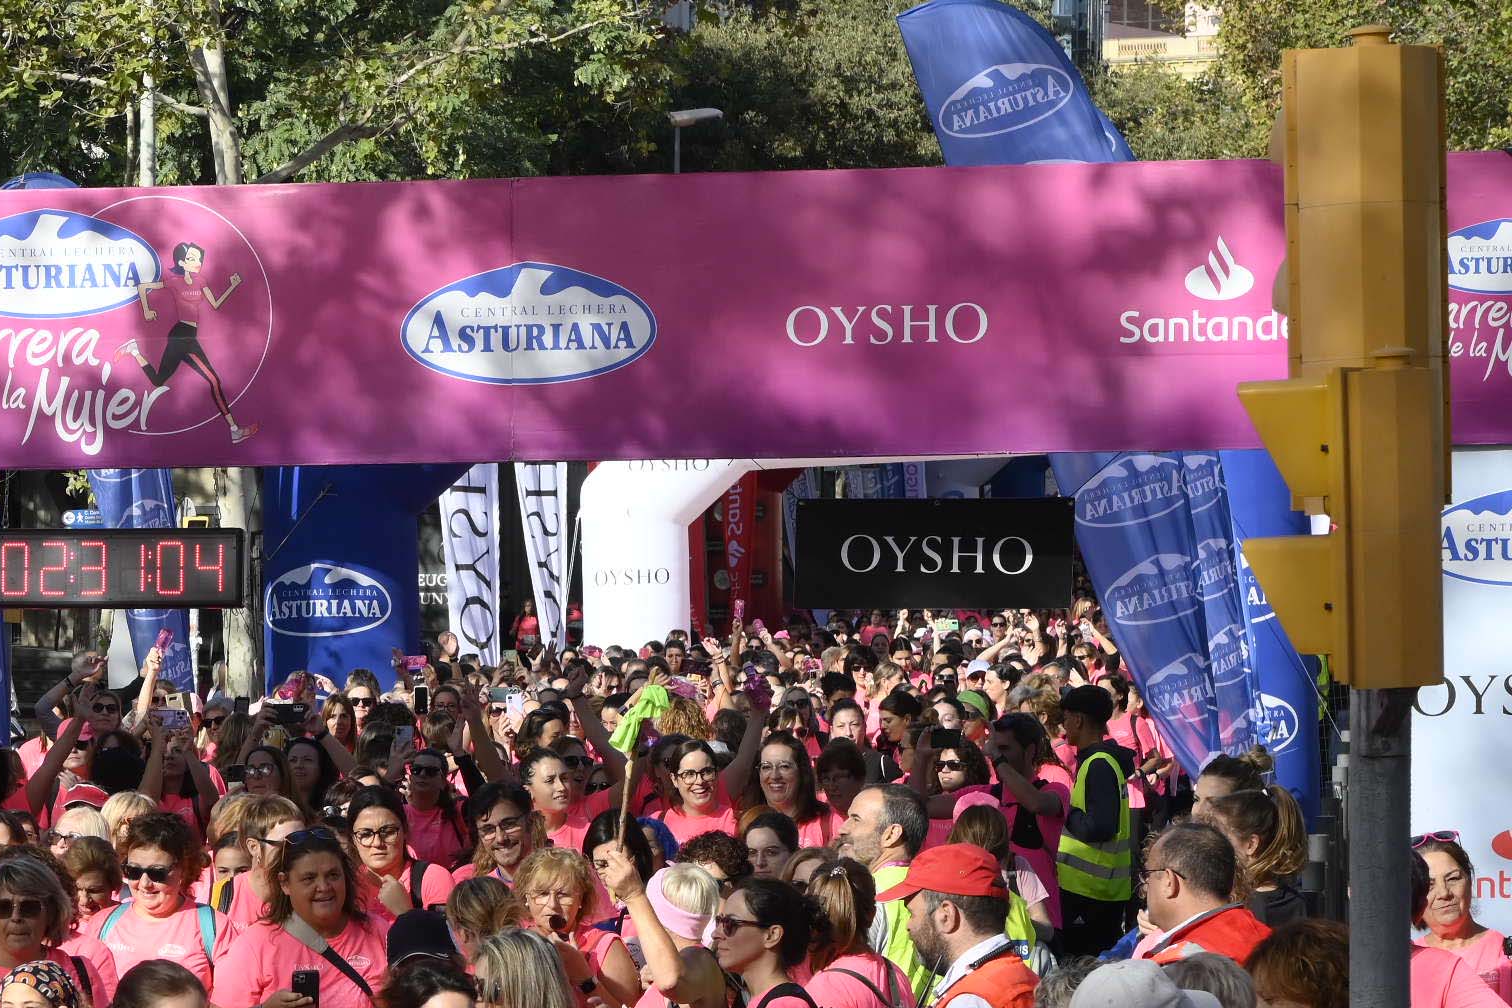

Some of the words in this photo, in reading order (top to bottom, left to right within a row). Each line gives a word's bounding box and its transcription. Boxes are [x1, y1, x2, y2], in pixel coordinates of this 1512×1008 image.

[64, 245, 136, 256] LECHERA
[461, 305, 538, 318] CENTRAL
[547, 303, 628, 315] LECHERA
[786, 302, 988, 346] OYSHO
[421, 310, 636, 353] ASTURIANA
[1470, 330, 1487, 357] la
[2, 369, 26, 410] la
[21, 362, 170, 456] Mujer
[840, 534, 1033, 575] OYSHO
[595, 567, 670, 586] OYSHO
[270, 593, 382, 620] ASTURIANA
